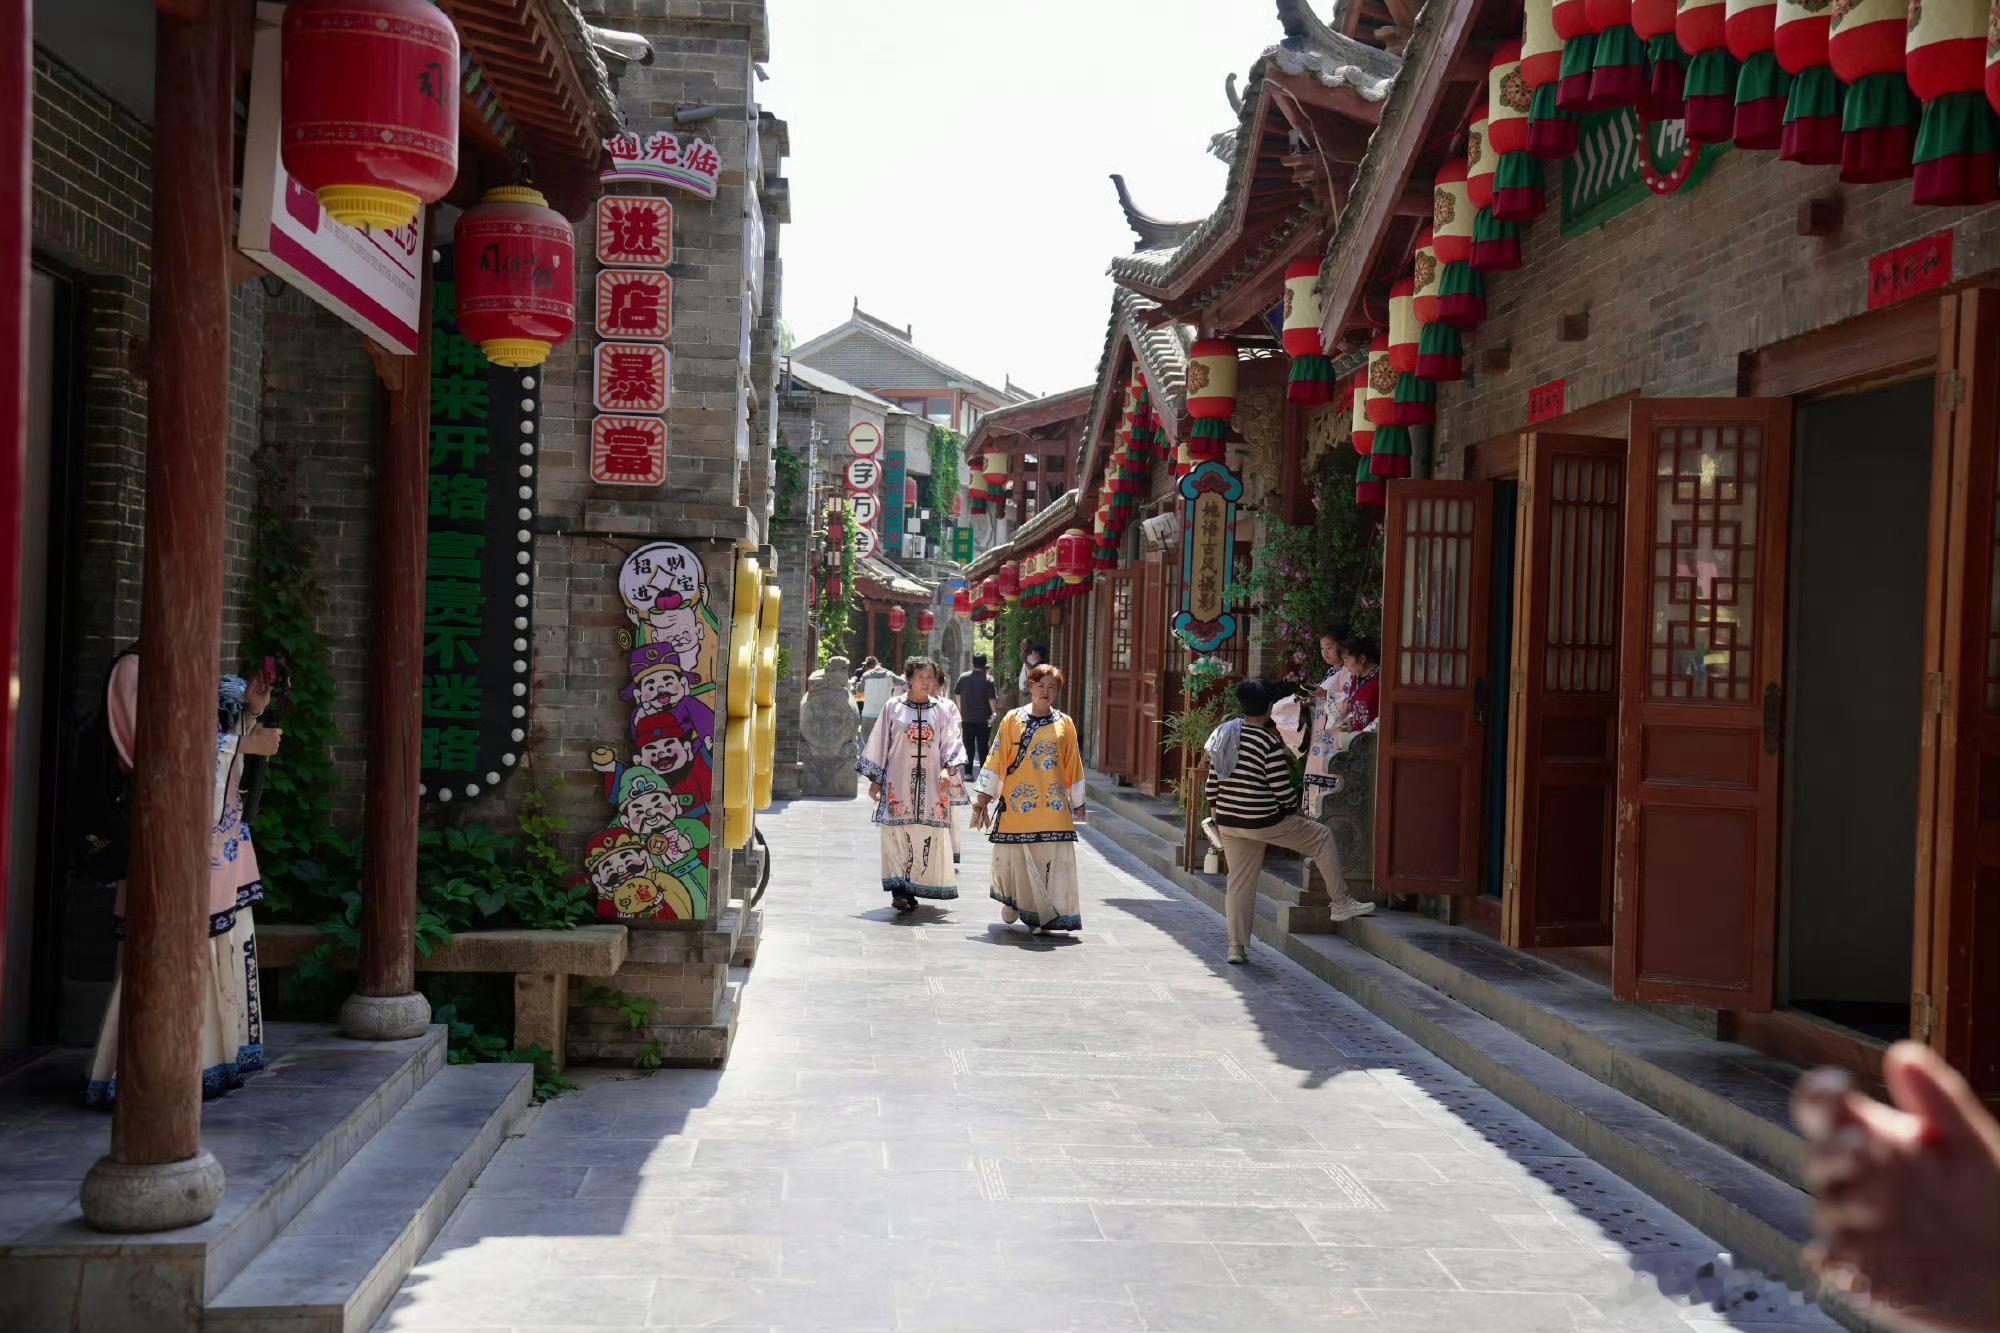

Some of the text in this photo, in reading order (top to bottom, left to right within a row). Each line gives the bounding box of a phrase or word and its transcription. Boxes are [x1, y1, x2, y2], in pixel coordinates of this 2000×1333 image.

[607, 134, 718, 177] 迎光临
[604, 206, 661, 474] 进店暴富
